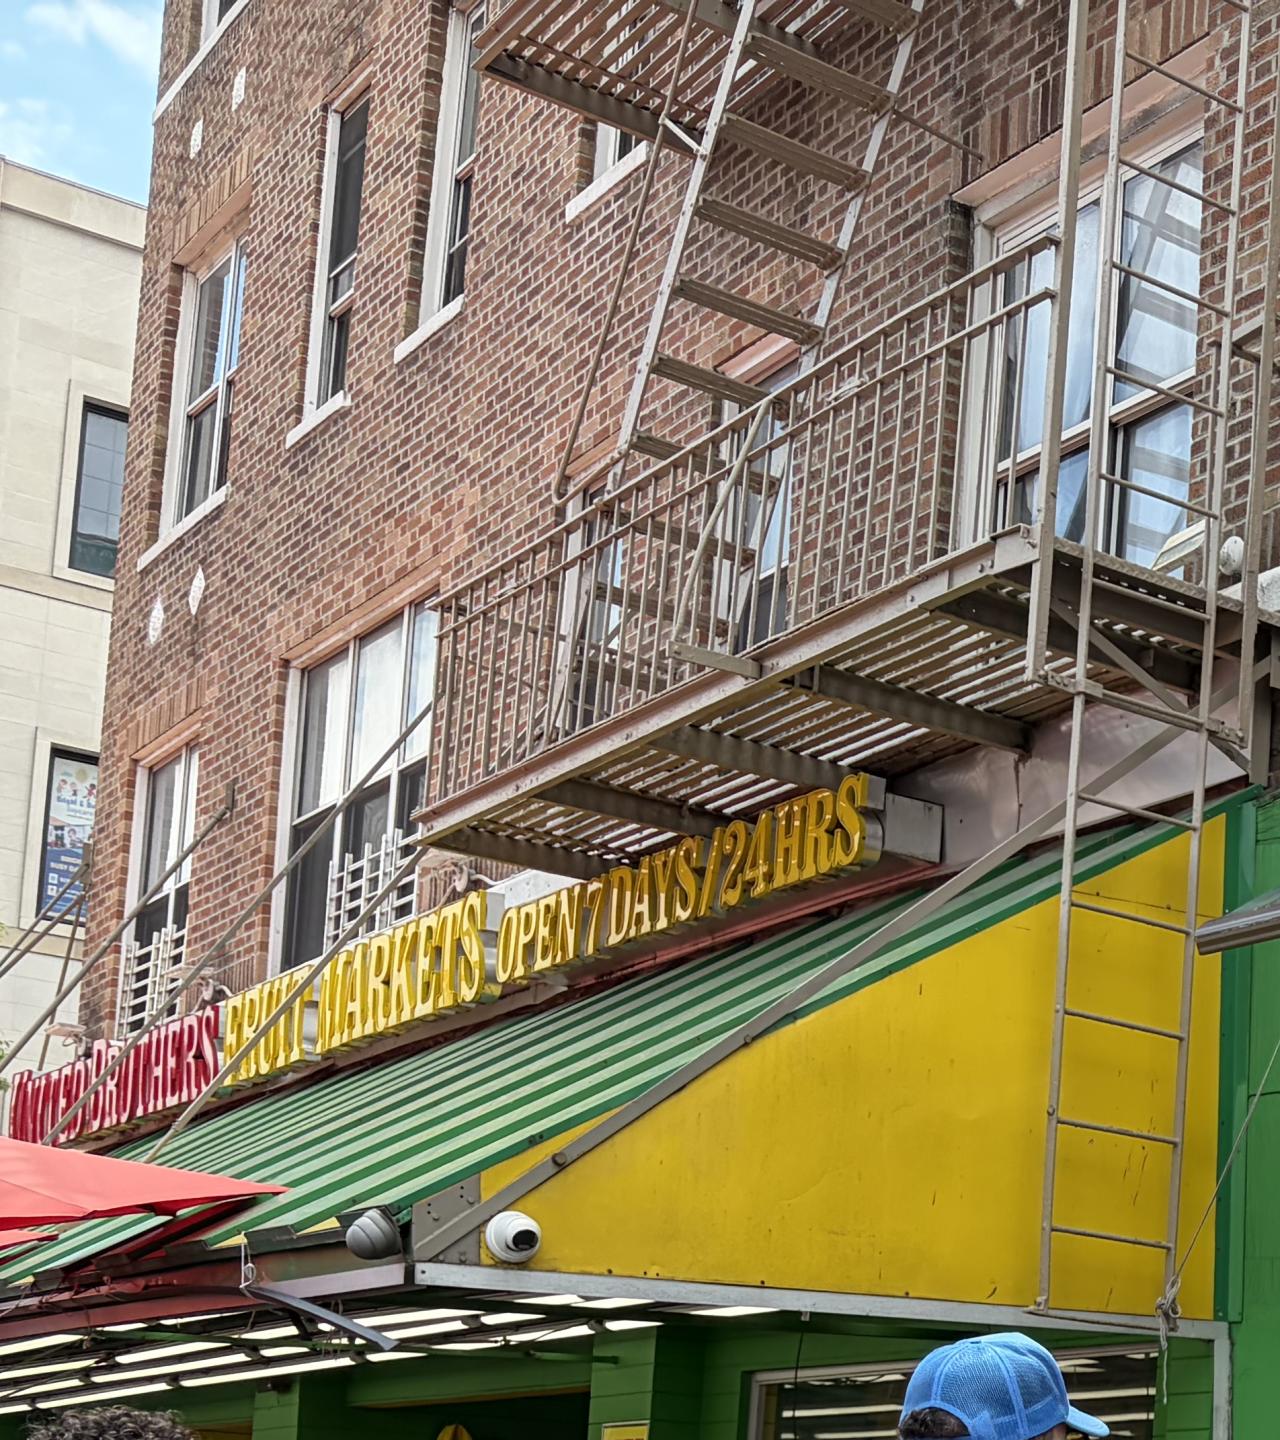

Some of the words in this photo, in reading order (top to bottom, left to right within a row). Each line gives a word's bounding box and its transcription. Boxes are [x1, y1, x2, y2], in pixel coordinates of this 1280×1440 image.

[90, 1005, 220, 1132] BROTHERS
[223, 967, 308, 1086] FRUIT
[315, 891, 486, 1053] MARKETS
[496, 884, 582, 982] OPEN
